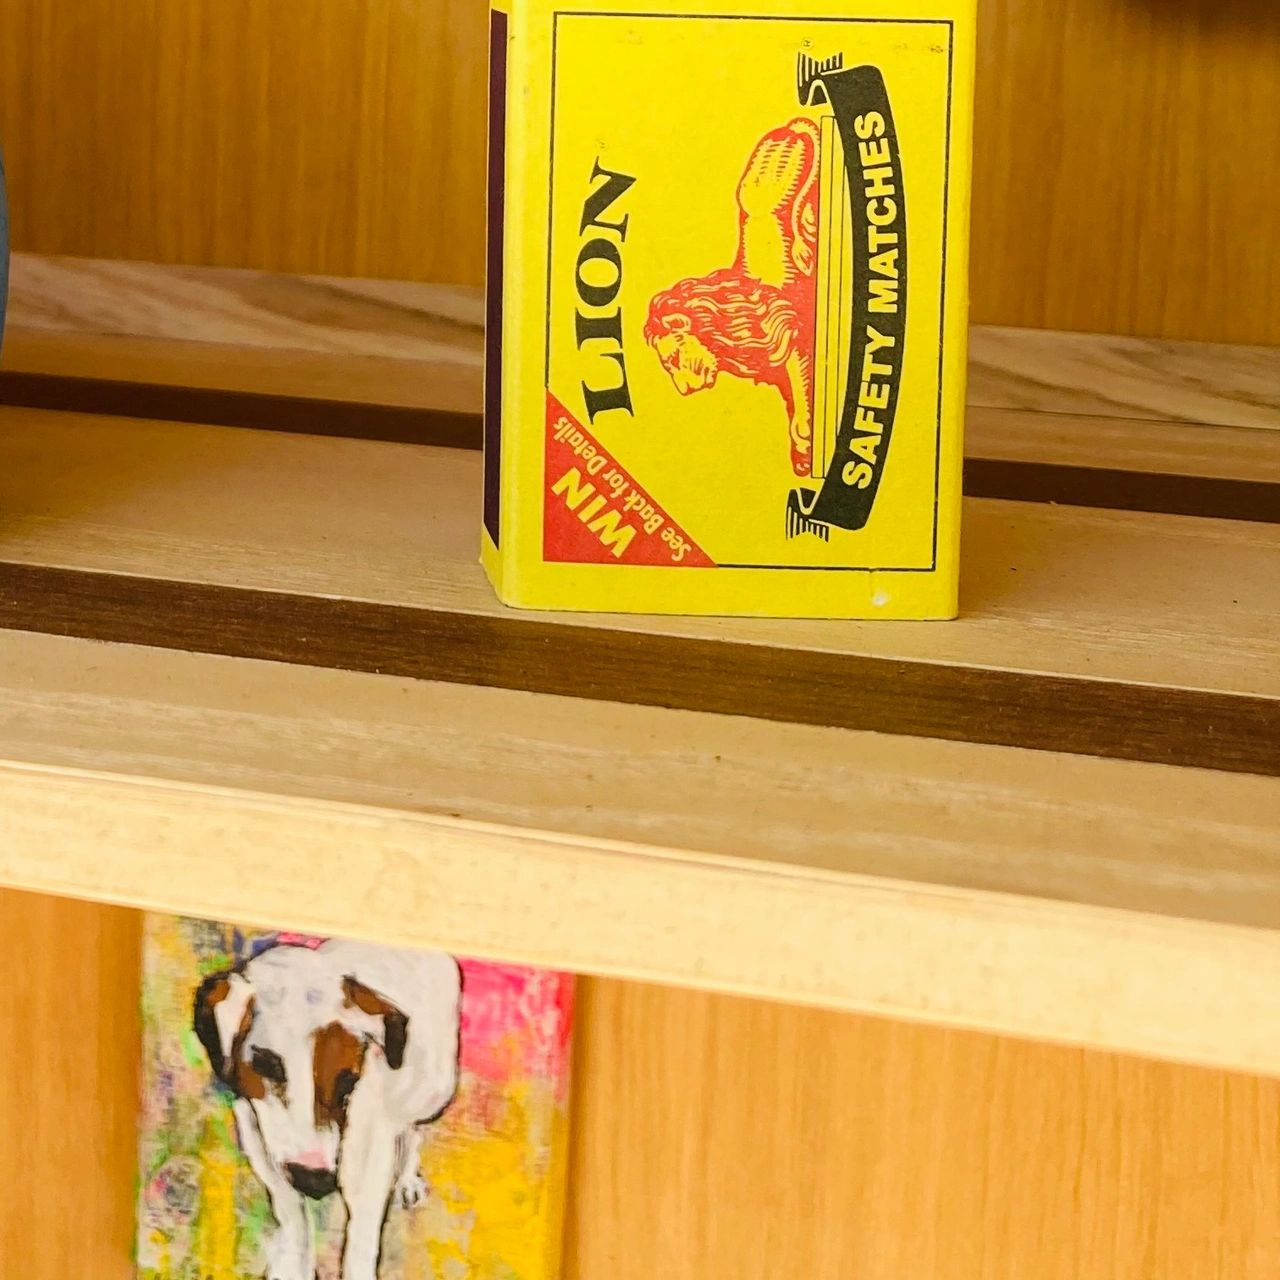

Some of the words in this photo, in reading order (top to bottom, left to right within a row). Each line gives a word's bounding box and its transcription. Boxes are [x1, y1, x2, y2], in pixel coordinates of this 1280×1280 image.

[854, 110, 899, 314] MATCHES
[575, 155, 637, 425] LION
[842, 325, 896, 490] SAFETY
[553, 416, 608, 476] Details
[602, 468, 630, 499] for
[551, 467, 637, 558] WIN
[623, 489, 665, 535] Back
[660, 526, 693, 562] See
